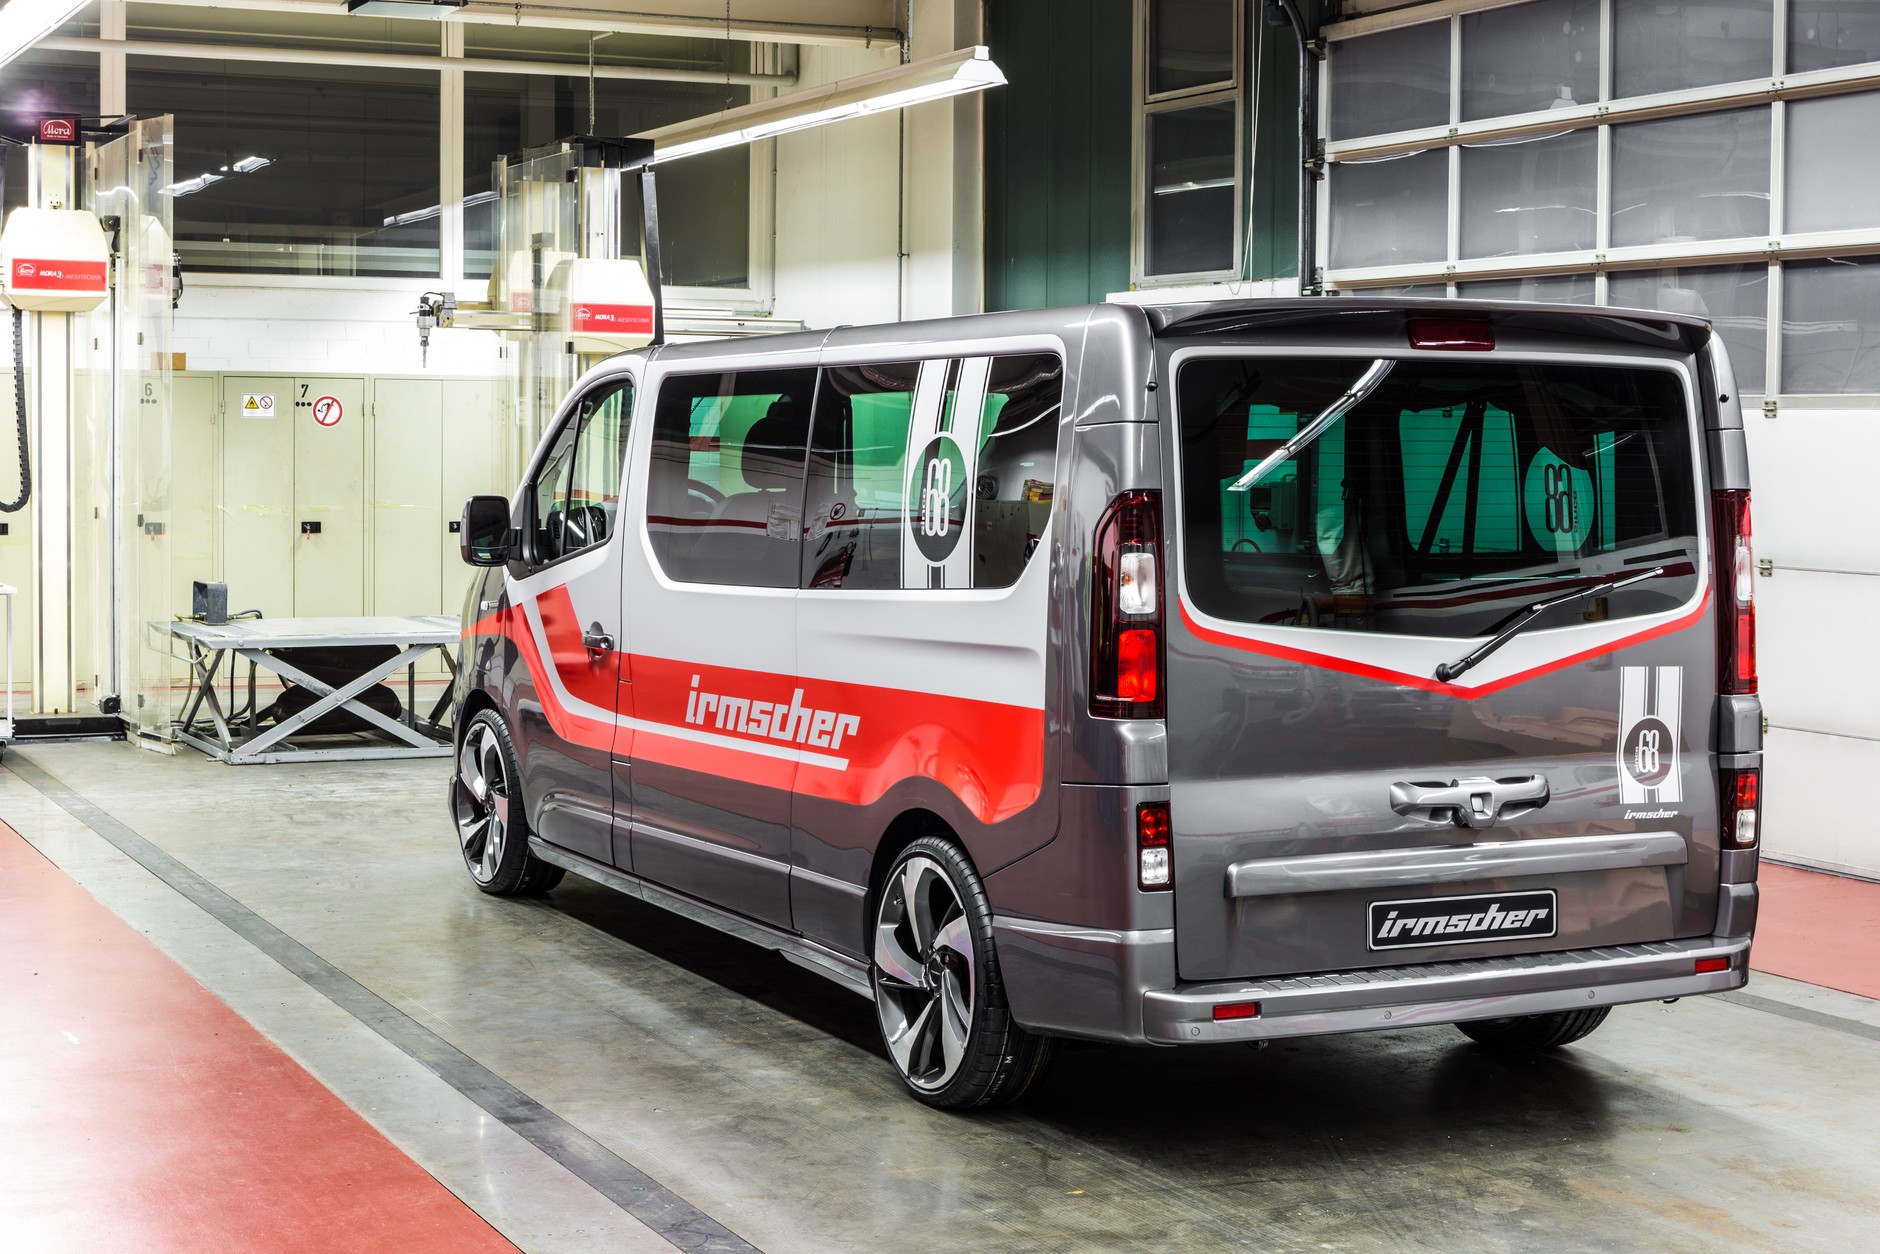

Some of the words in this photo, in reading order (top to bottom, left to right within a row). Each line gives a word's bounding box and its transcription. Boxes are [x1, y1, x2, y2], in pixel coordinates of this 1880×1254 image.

[44, 122, 72, 135] Mora
[145, 382, 152, 396] 6
[301, 384, 308, 398] 7
[925, 458, 951, 537] 68
[685, 674, 861, 750] irmscher
[1638, 730, 1660, 773] 68
[1624, 808, 1678, 820] irmscher
[1377, 904, 1550, 938] irmscher
